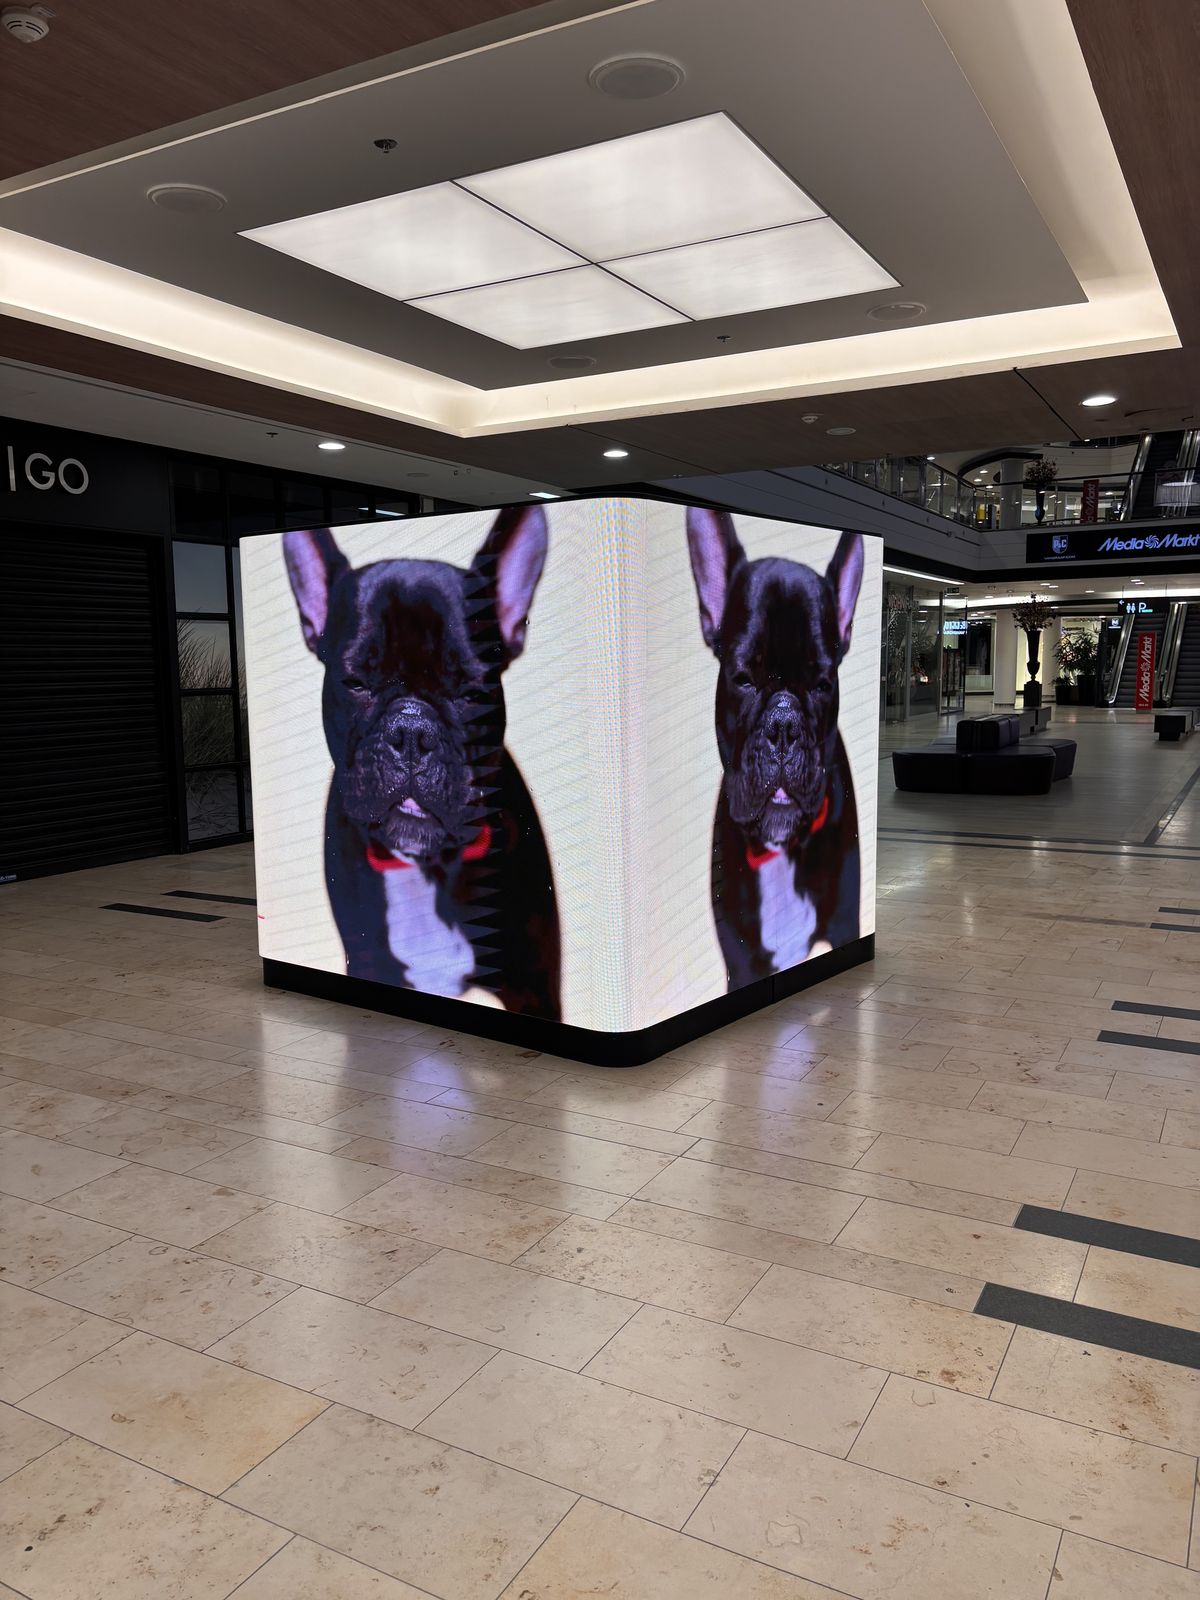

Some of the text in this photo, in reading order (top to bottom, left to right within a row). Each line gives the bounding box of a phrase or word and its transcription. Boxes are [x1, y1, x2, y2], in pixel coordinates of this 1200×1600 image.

[1097, 533, 1200, 552] Media Markt
[1138, 602, 1147, 614] P
[1141, 636, 1153, 664] Markt
[1139, 671, 1151, 702] Media
